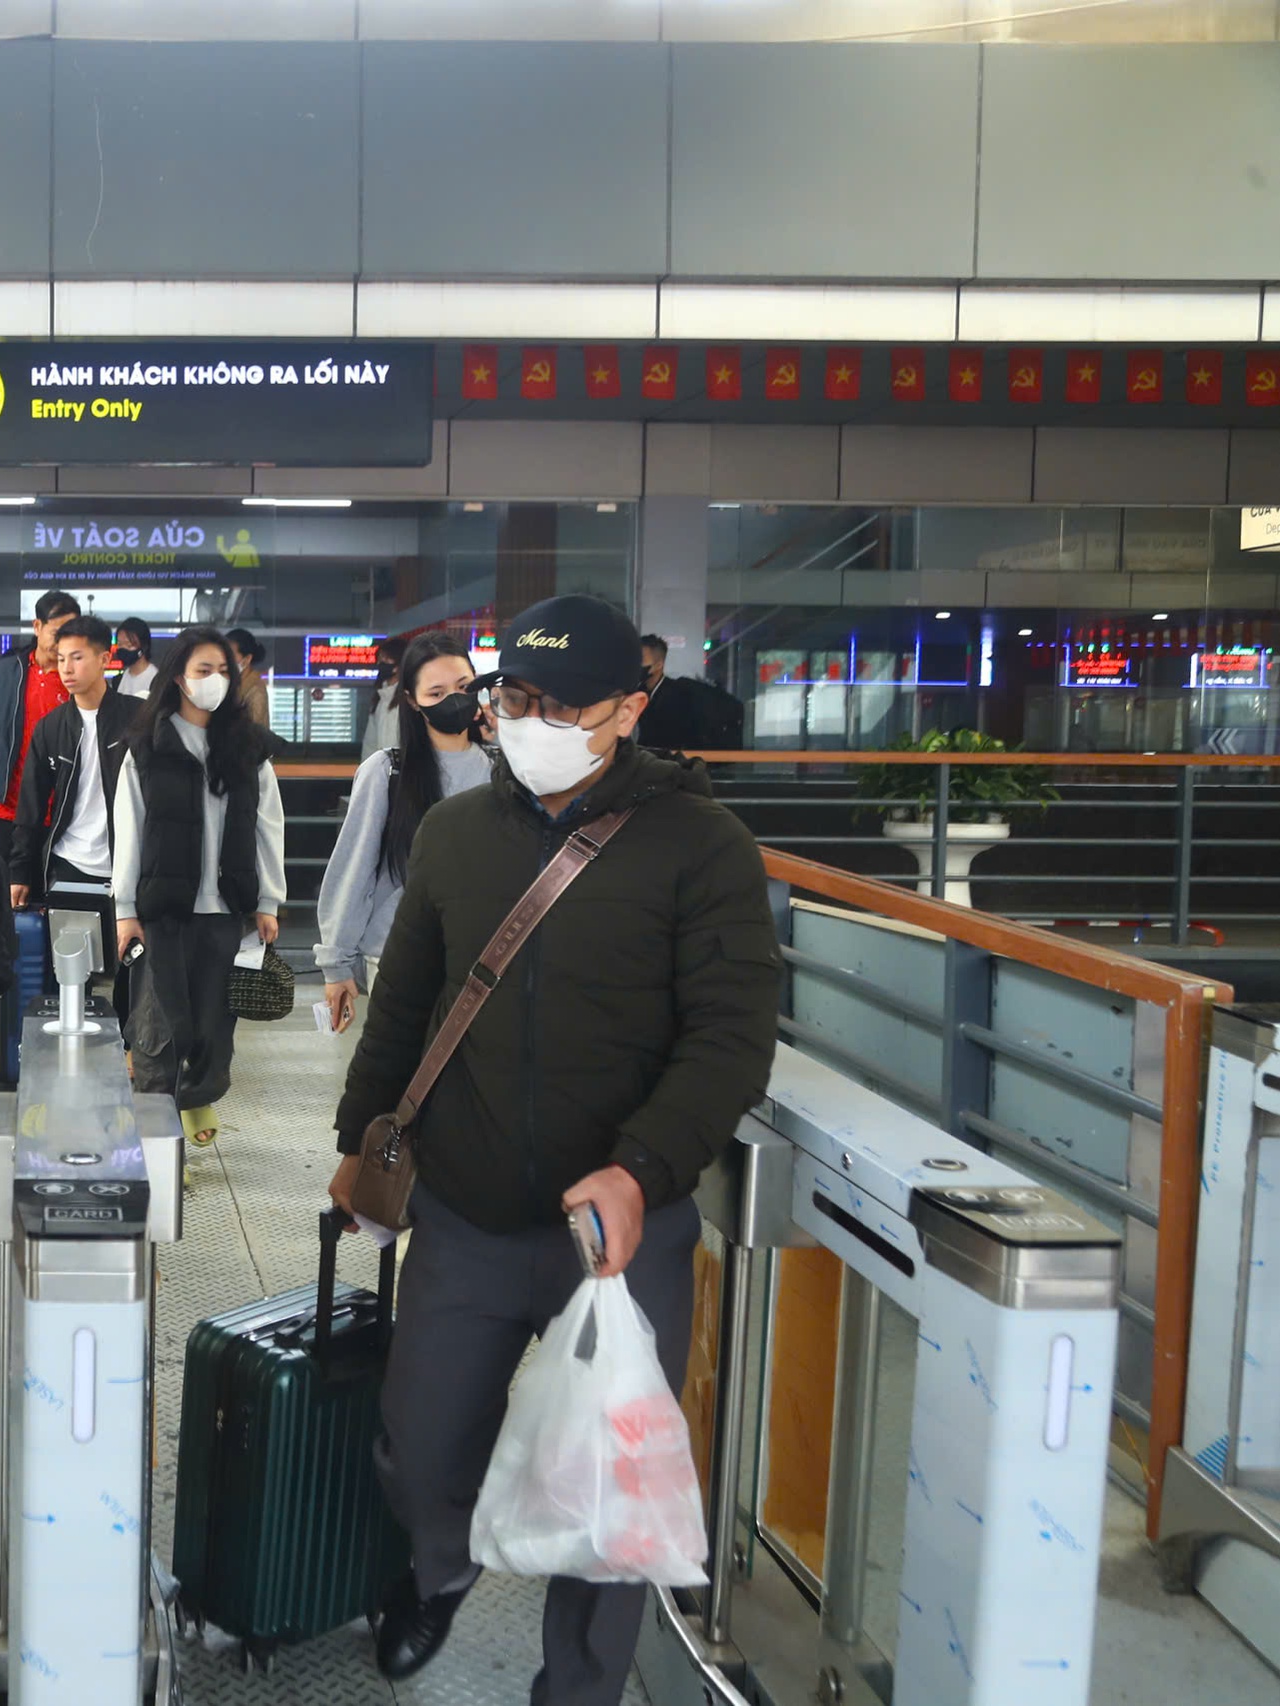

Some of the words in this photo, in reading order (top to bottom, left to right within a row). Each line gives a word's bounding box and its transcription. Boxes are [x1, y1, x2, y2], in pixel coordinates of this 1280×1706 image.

[31, 361, 93, 386] HÀNH
[100, 361, 177, 385] KHÁCH
[184, 360, 264, 385] KHÔNG
[270, 365, 299, 384] RA
[304, 357, 338, 384] LỐI
[344, 360, 390, 384] NÀY
[31, 399, 86, 422] Entry
[91, 398, 142, 422] Only
